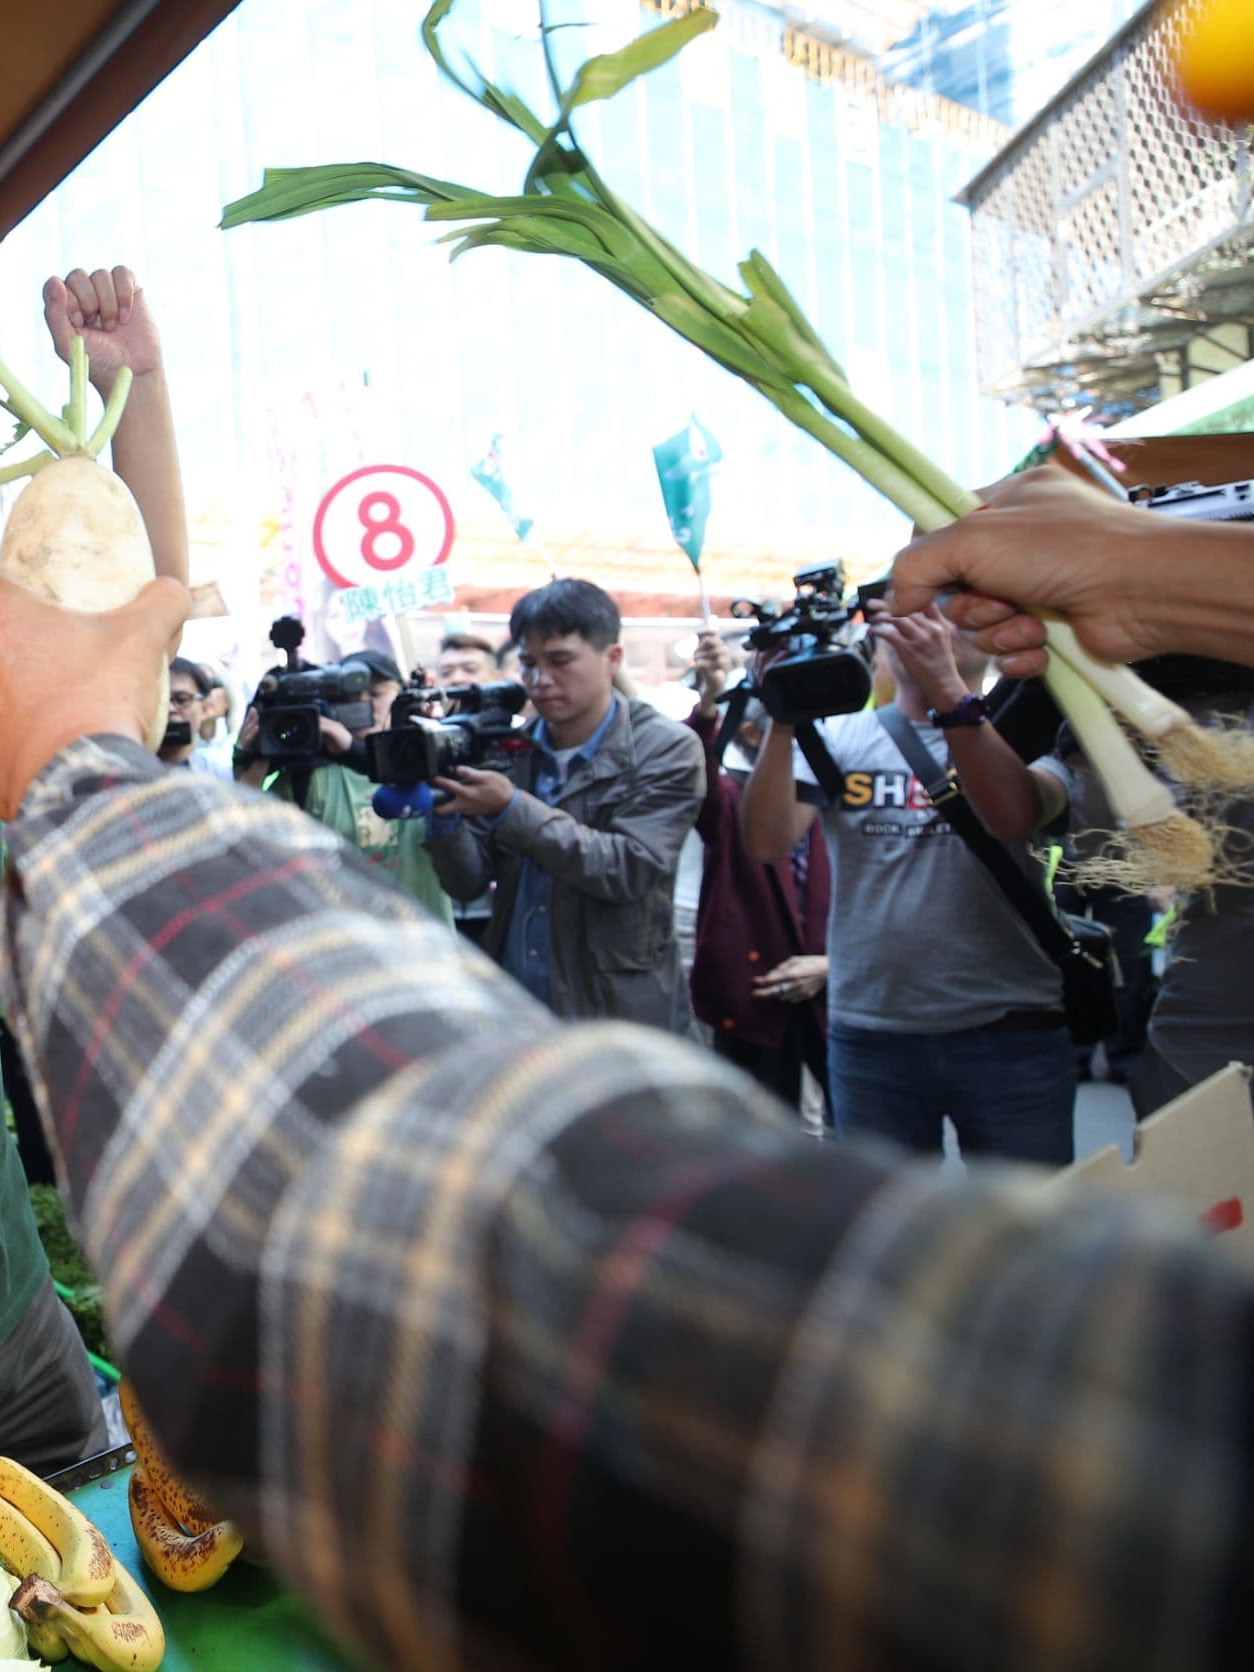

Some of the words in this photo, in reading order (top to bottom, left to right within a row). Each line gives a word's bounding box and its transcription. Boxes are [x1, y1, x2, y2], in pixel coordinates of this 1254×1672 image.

[358, 490, 415, 571] 8
[345, 567, 452, 621] 陳怡君
